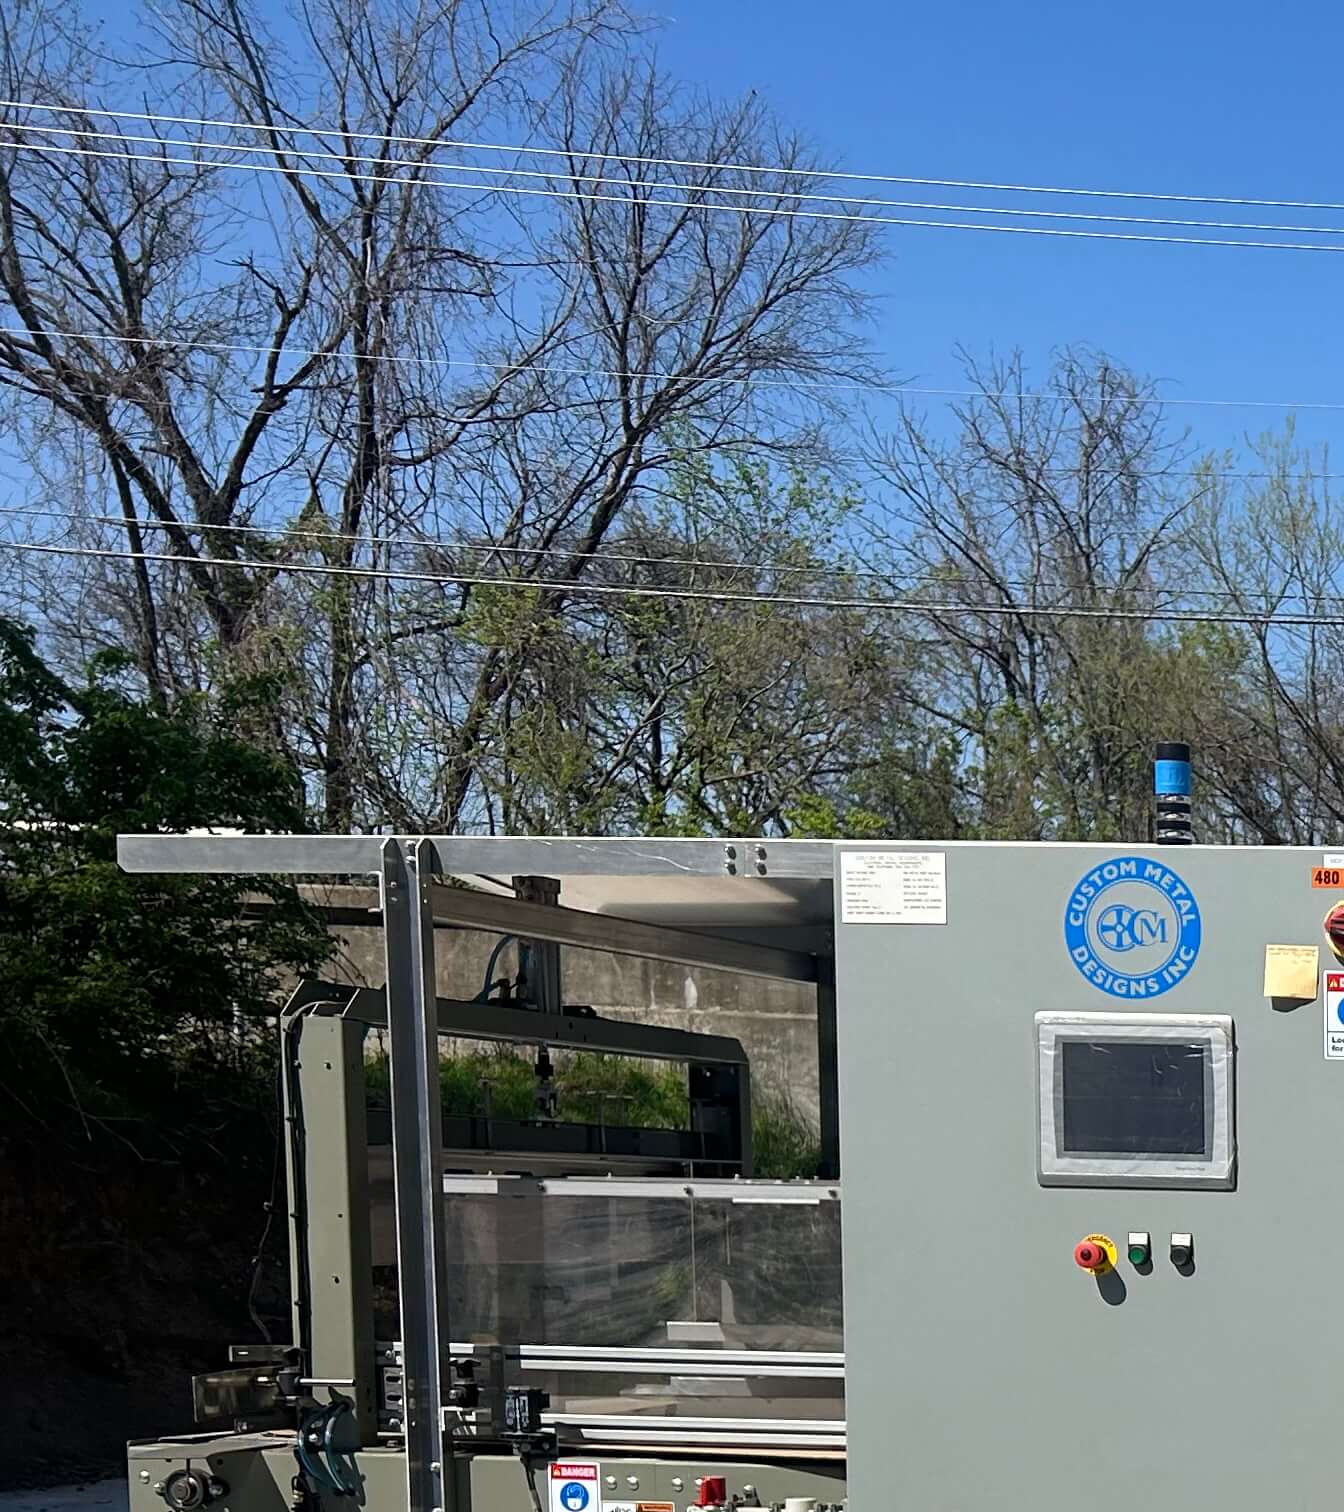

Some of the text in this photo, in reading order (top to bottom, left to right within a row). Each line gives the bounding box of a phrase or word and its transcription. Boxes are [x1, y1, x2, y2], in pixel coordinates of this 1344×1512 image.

[1070, 860, 1196, 927] CUSTOM METAL
[1314, 870, 1340, 885] 480
[1072, 945, 1195, 996] DESIGNS INC
[560, 1466, 596, 1478] DANGER
